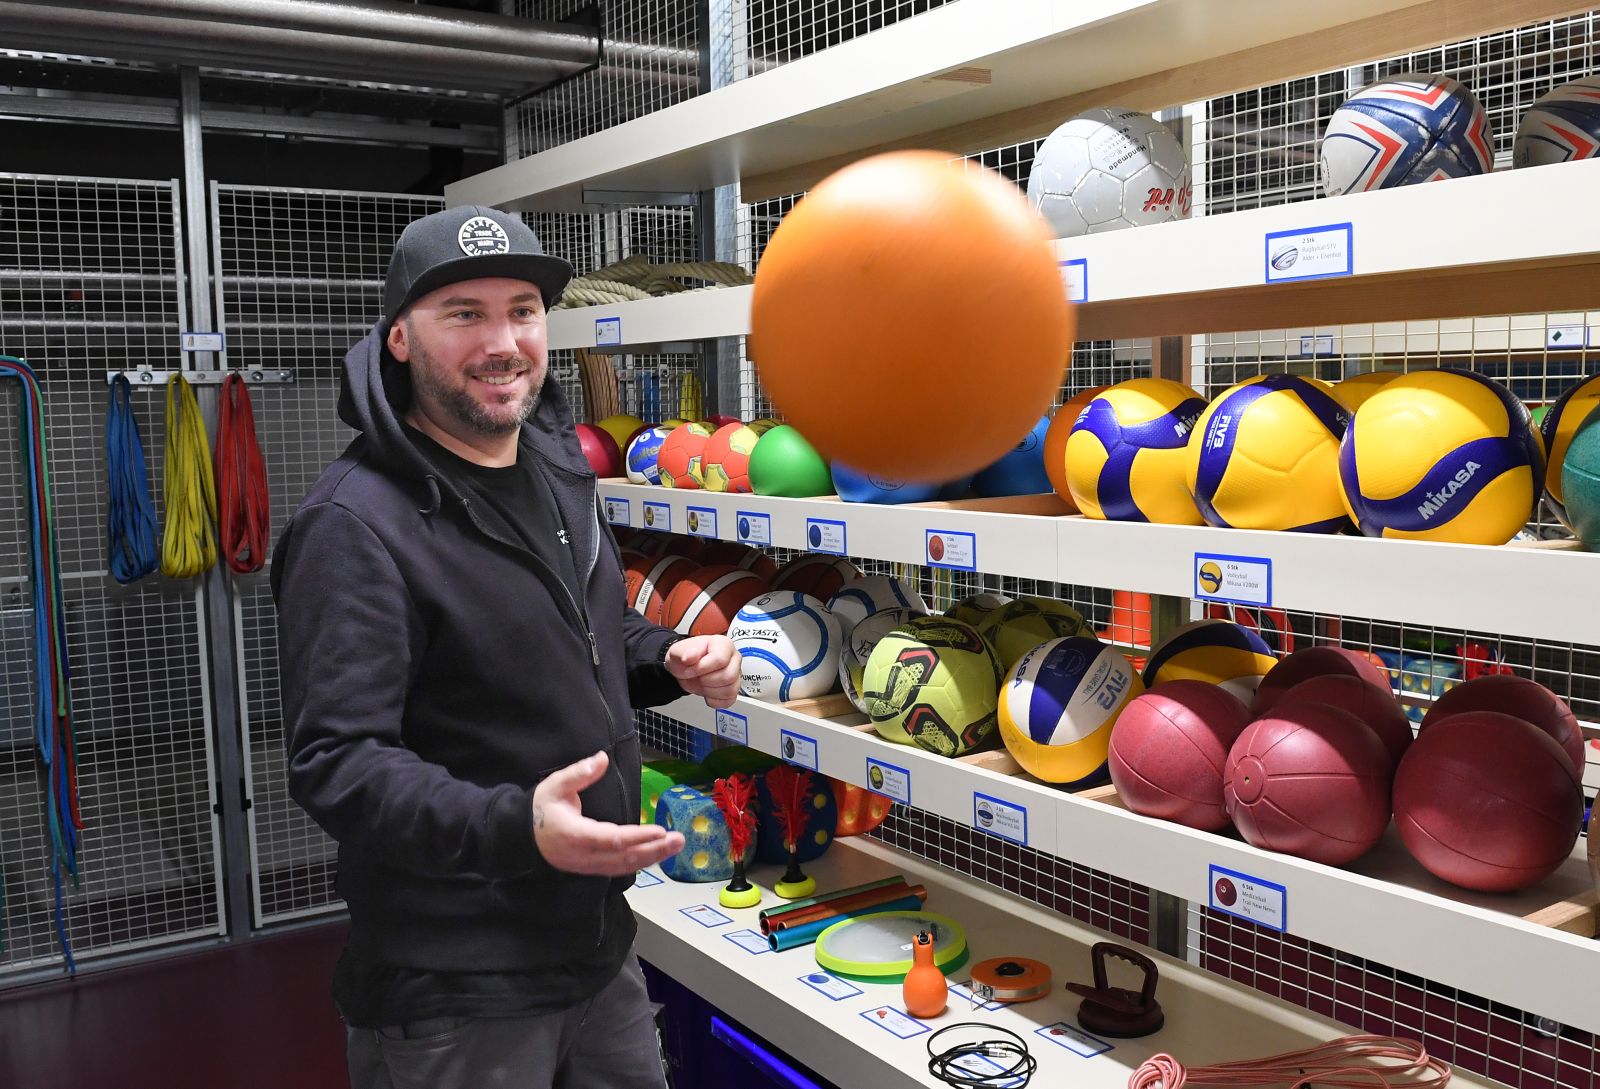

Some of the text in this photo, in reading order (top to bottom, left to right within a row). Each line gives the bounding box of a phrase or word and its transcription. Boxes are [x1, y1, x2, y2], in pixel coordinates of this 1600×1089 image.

[1109, 144, 1147, 171] Handmade
[463, 219, 506, 239] BRIXTON
[1306, 236, 1315, 244] Stk
[1336, 412, 1350, 429] V2
[1213, 415, 1232, 449] FIVB
[1096, 669, 1128, 711] FIVB
[1246, 884, 1254, 892] Stk
